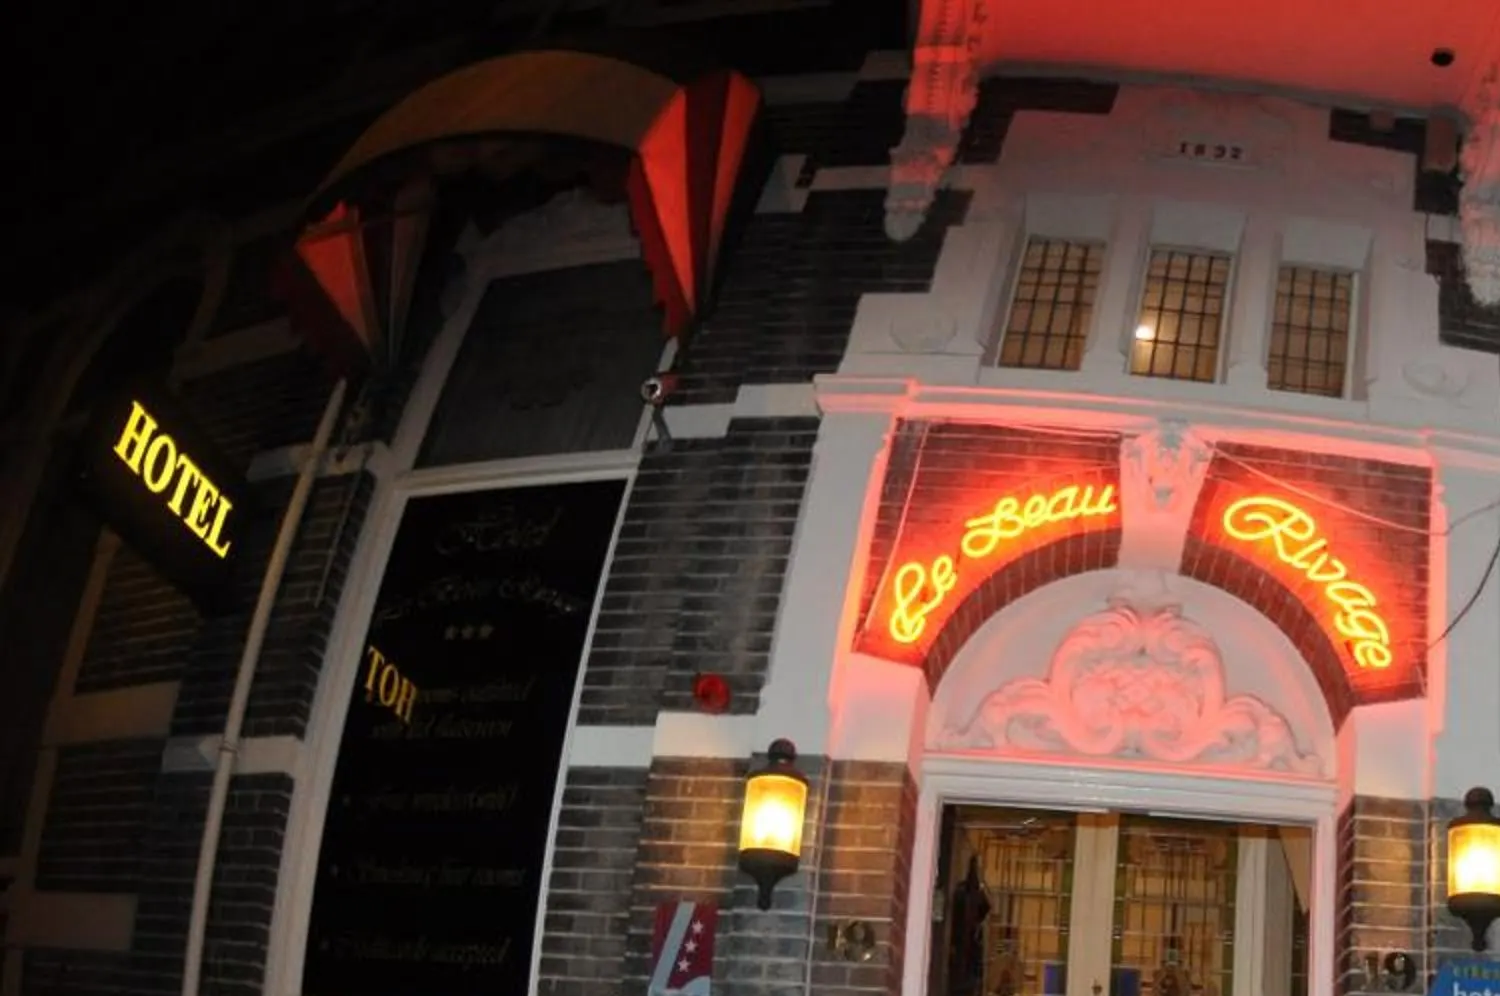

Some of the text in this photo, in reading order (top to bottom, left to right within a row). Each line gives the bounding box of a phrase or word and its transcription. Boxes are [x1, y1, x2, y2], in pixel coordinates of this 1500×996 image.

[113, 400, 234, 558] HOTEL
[889, 484, 1391, 670] Le Beau Rivage
